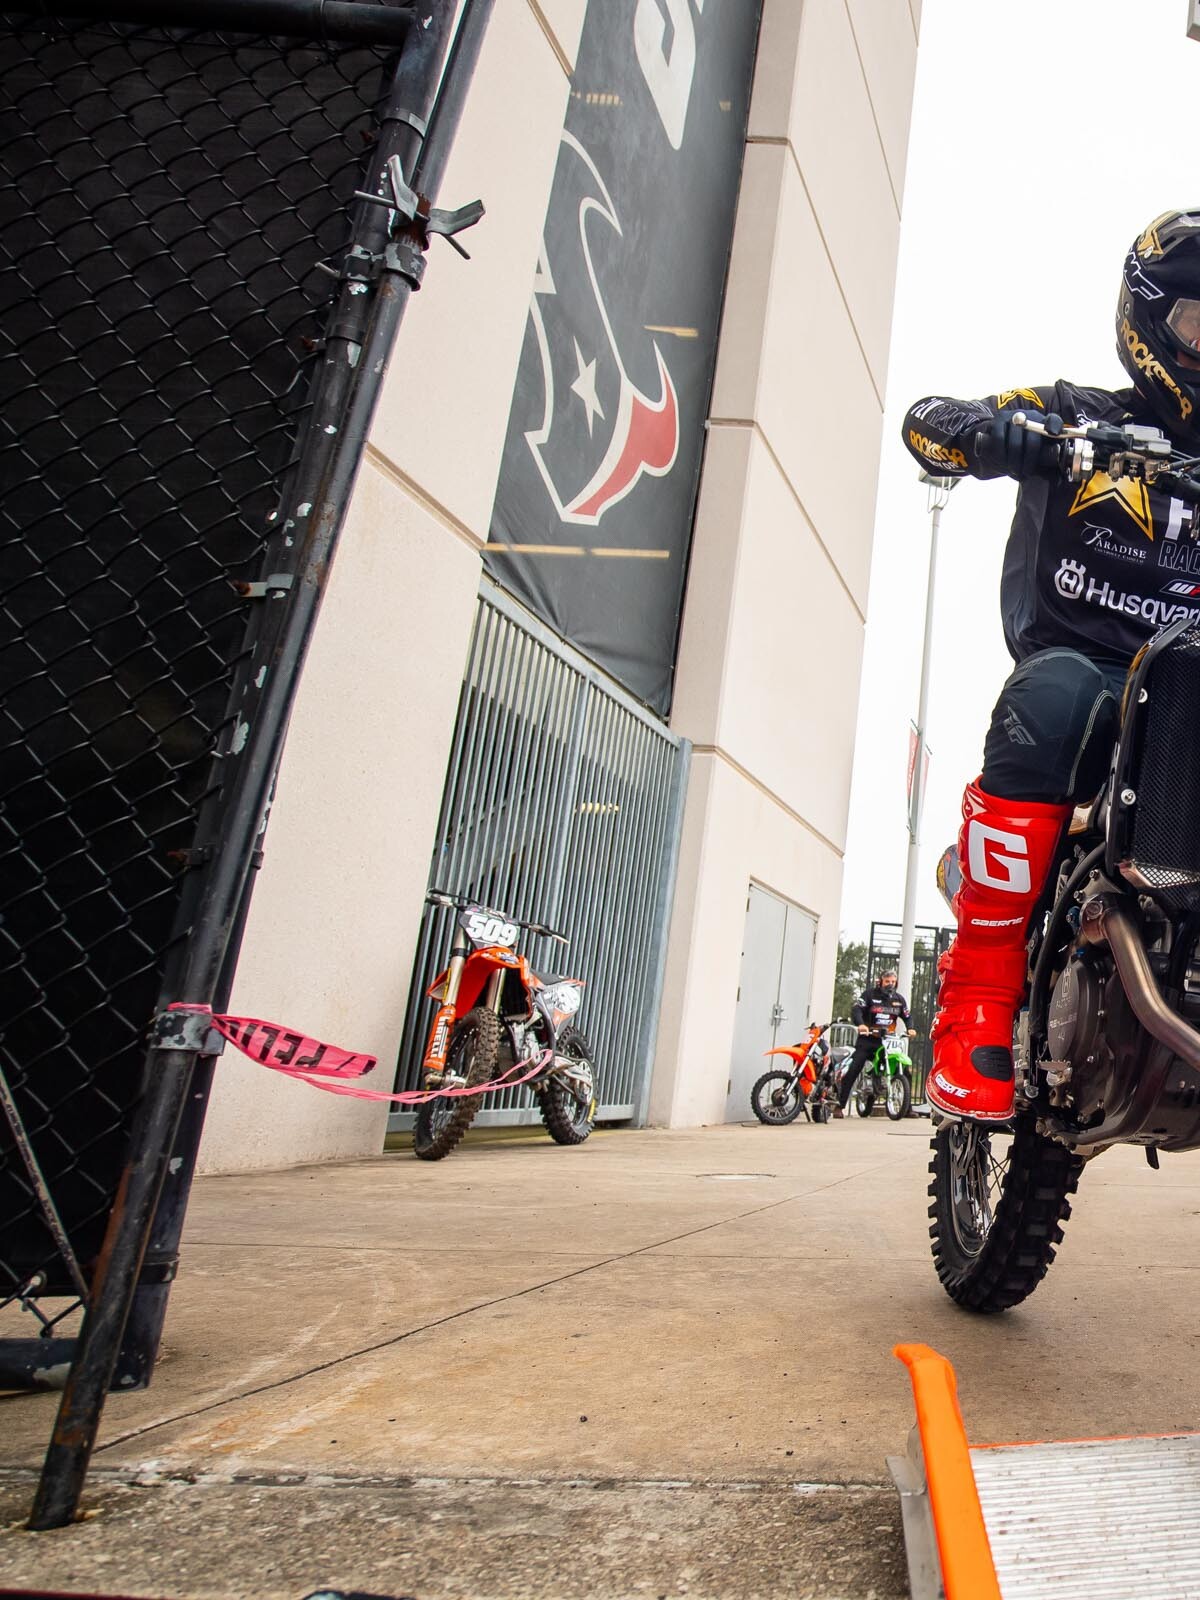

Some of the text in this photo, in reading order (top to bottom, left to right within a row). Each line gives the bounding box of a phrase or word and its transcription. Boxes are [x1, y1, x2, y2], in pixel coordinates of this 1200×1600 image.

[1080, 520, 1148, 559] PARADISE
[968, 819, 1032, 894] G
[466, 914, 519, 948] 509
